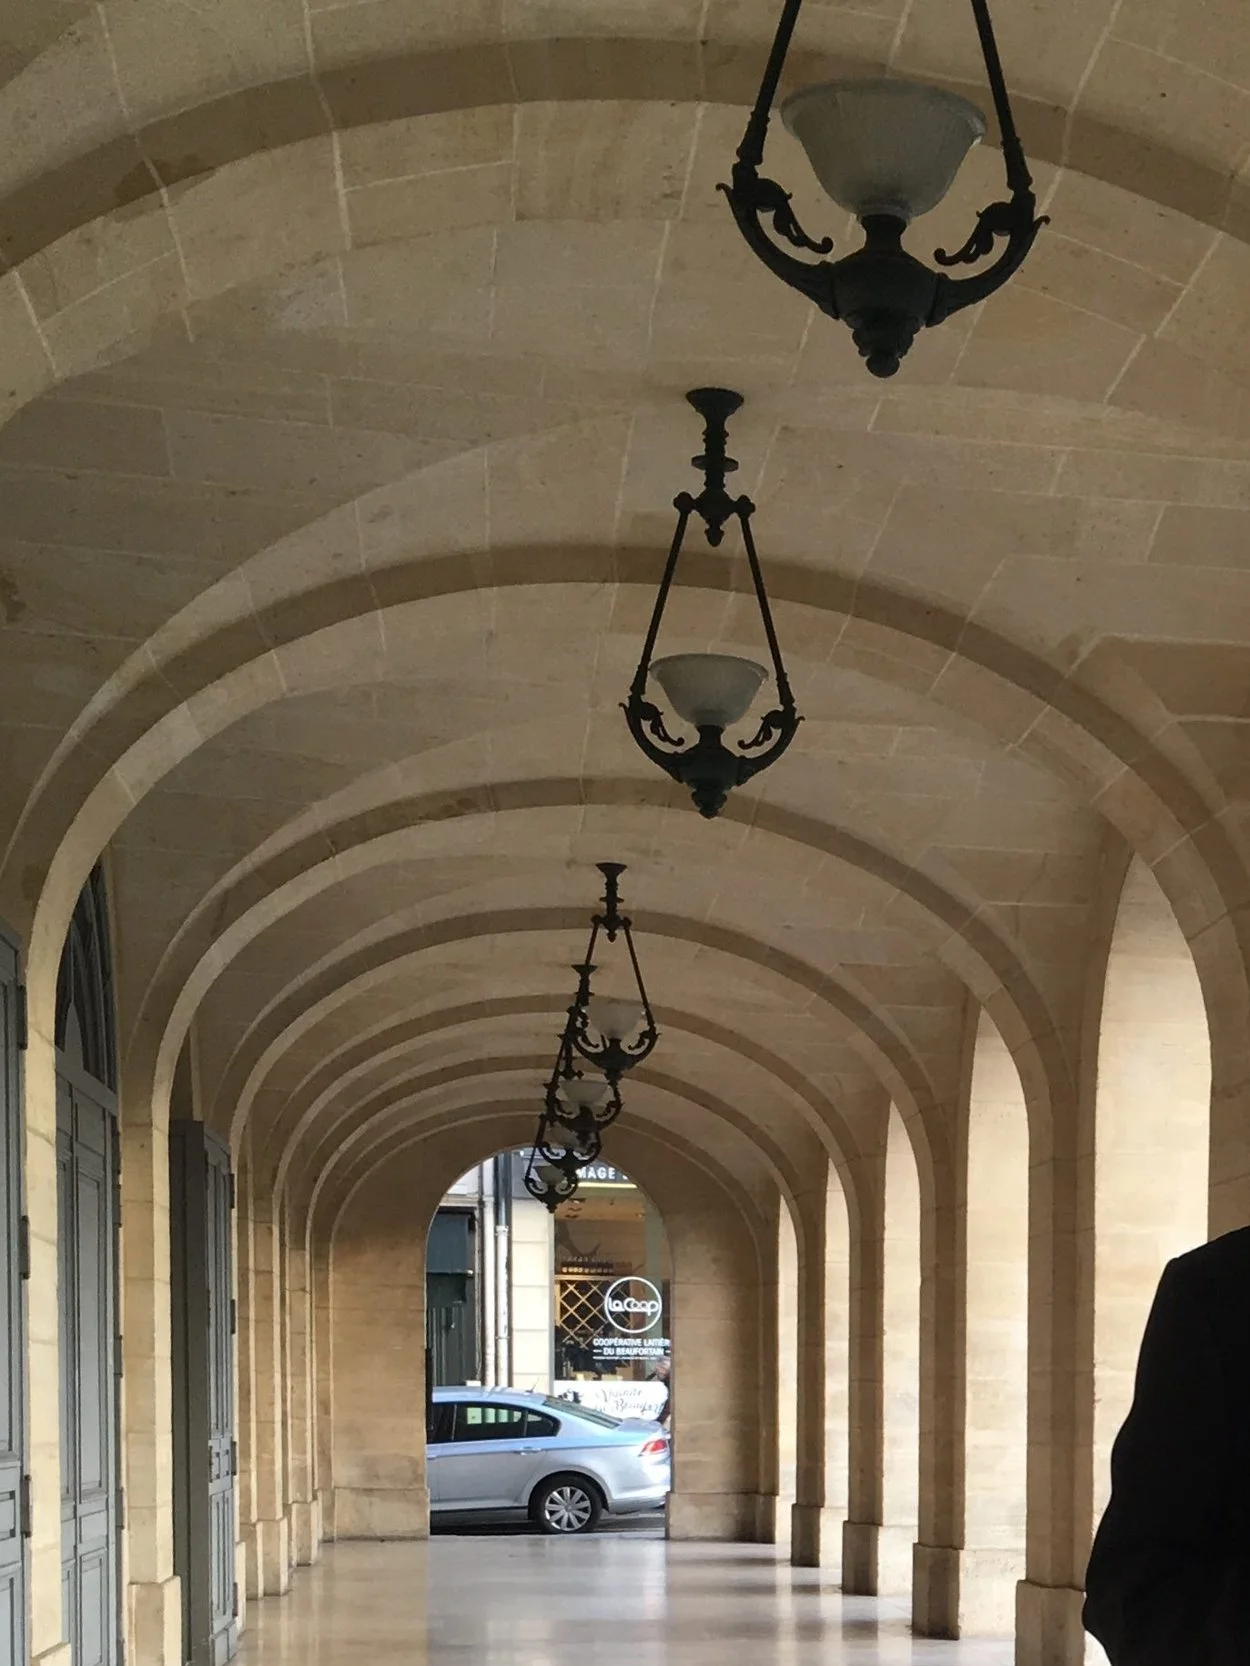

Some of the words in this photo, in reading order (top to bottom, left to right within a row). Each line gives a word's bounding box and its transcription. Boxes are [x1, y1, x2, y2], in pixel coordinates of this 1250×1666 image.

[575, 1166, 616, 1180] MAGE
[643, 1337, 671, 1346] LAITIÈR
[603, 1347, 615, 1356] DU
